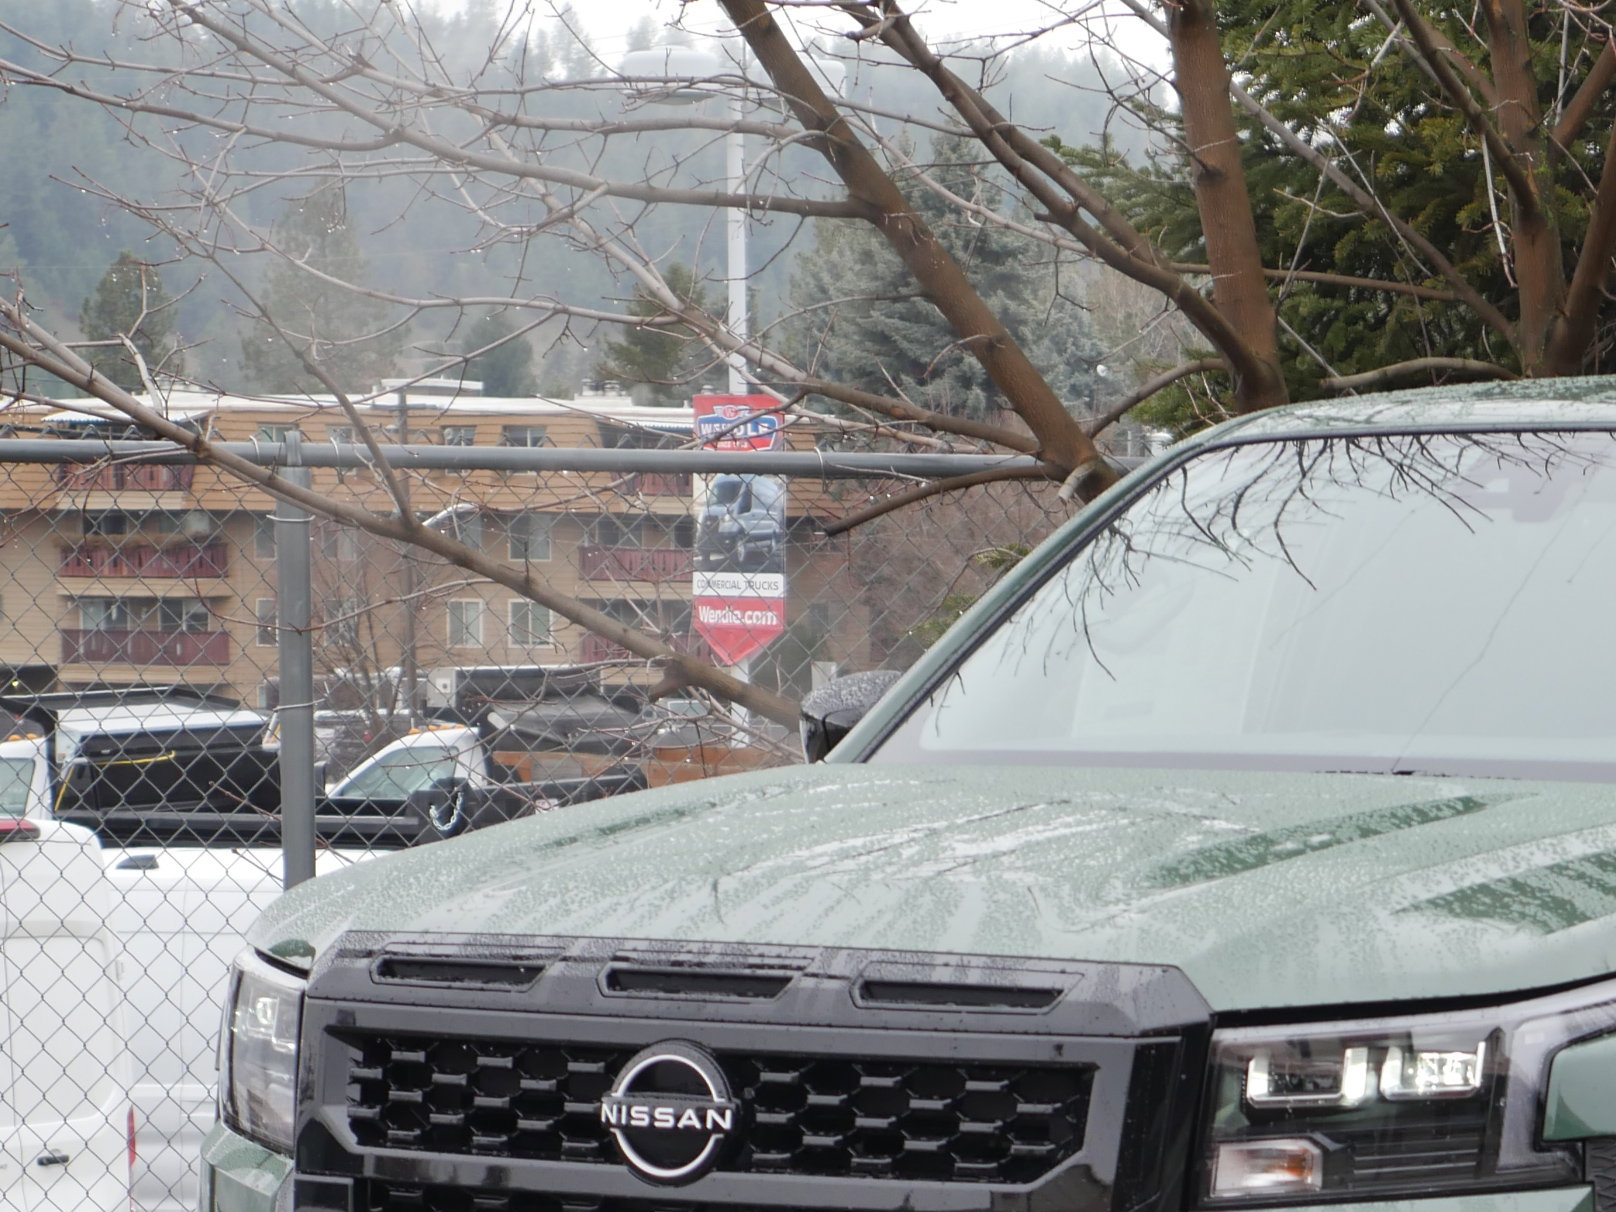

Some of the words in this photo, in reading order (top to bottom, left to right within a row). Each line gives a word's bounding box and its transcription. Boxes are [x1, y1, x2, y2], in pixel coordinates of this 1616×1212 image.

[744, 580, 779, 591] TRUCKS
[698, 605, 777, 626] Wendle.com
[601, 1103, 732, 1130] NISSAN
